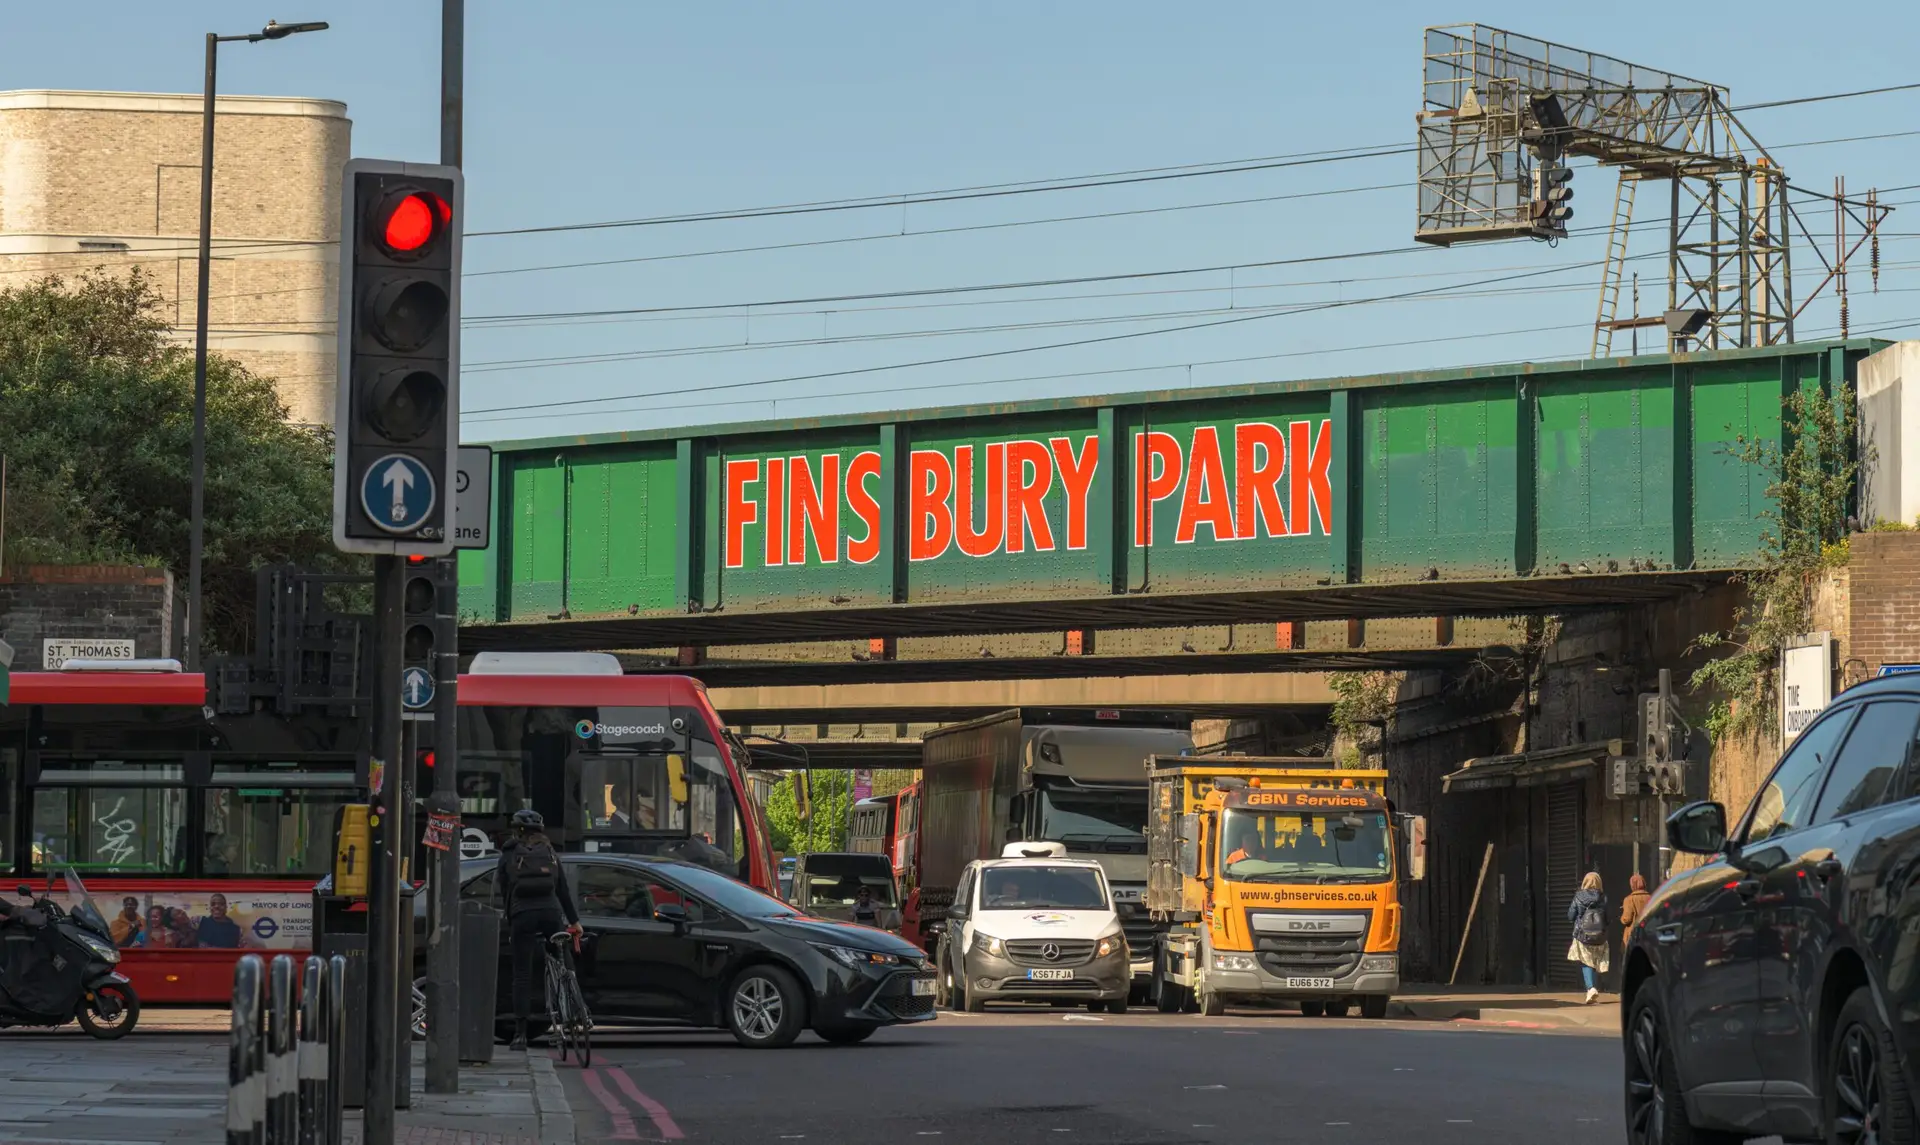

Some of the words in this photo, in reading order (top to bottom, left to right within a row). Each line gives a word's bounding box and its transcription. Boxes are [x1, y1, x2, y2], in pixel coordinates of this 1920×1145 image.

[1134, 419, 1332, 548] PARK
[455, 526, 482, 539] ane
[47, 645, 66, 657] ST.
[70, 645, 131, 658] THOMAS'S
[47, 657, 68, 669] RO
[1787, 685, 1800, 707] TIME
[594, 723, 665, 737] Stagecoach
[1247, 793, 1288, 805] GBN
[1295, 793, 1368, 807] Services
[1113, 890, 1137, 898] AF
[1240, 889, 1378, 904] www.gbnservices.co.uk
[1288, 921, 1331, 930] DAF
[1032, 970, 1054, 979] KS67
[1056, 970, 1072, 979] FJA
[1289, 979, 1311, 987] EU66
[1313, 979, 1330, 987] SYZ
